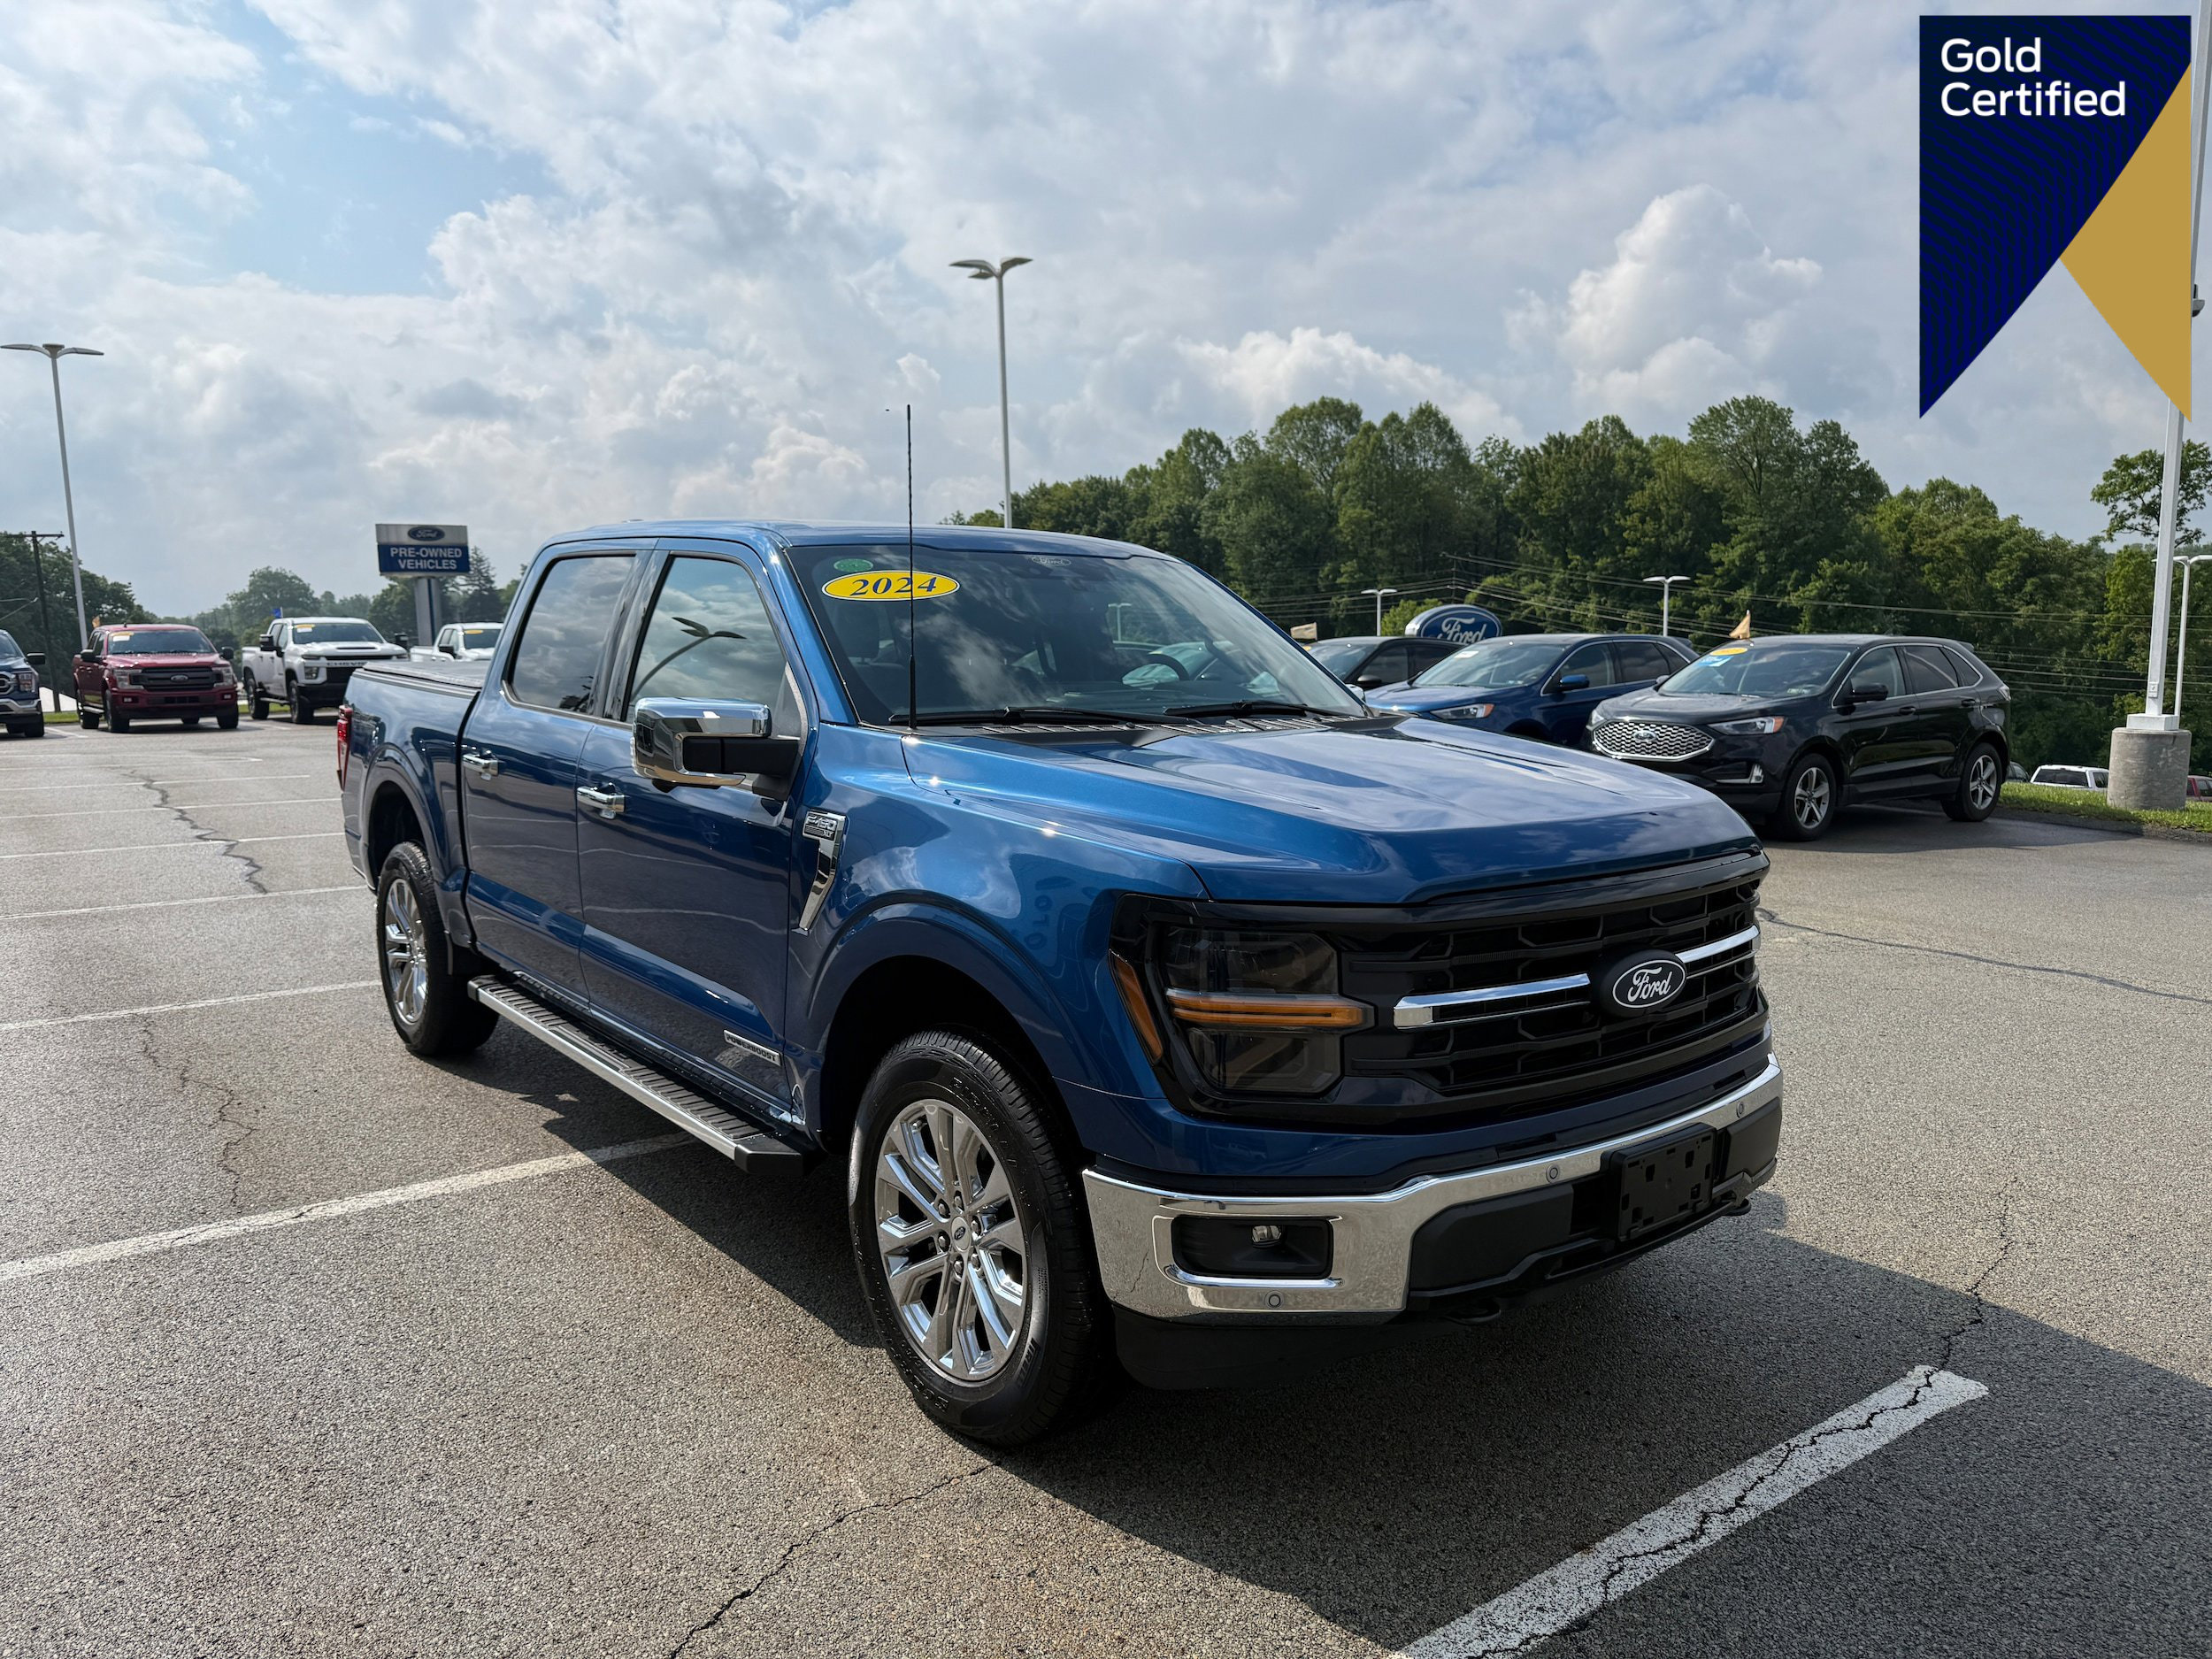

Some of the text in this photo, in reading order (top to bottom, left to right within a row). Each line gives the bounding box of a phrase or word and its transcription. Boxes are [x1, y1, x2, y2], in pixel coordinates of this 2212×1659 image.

[389, 547, 463, 558] PRE-OWNED
[397, 558, 457, 570] VEHICLES
[849, 576, 937, 596] 2024
[1627, 966, 1672, 1002] Ford
[726, 1033, 777, 1062] POWERBOOST
